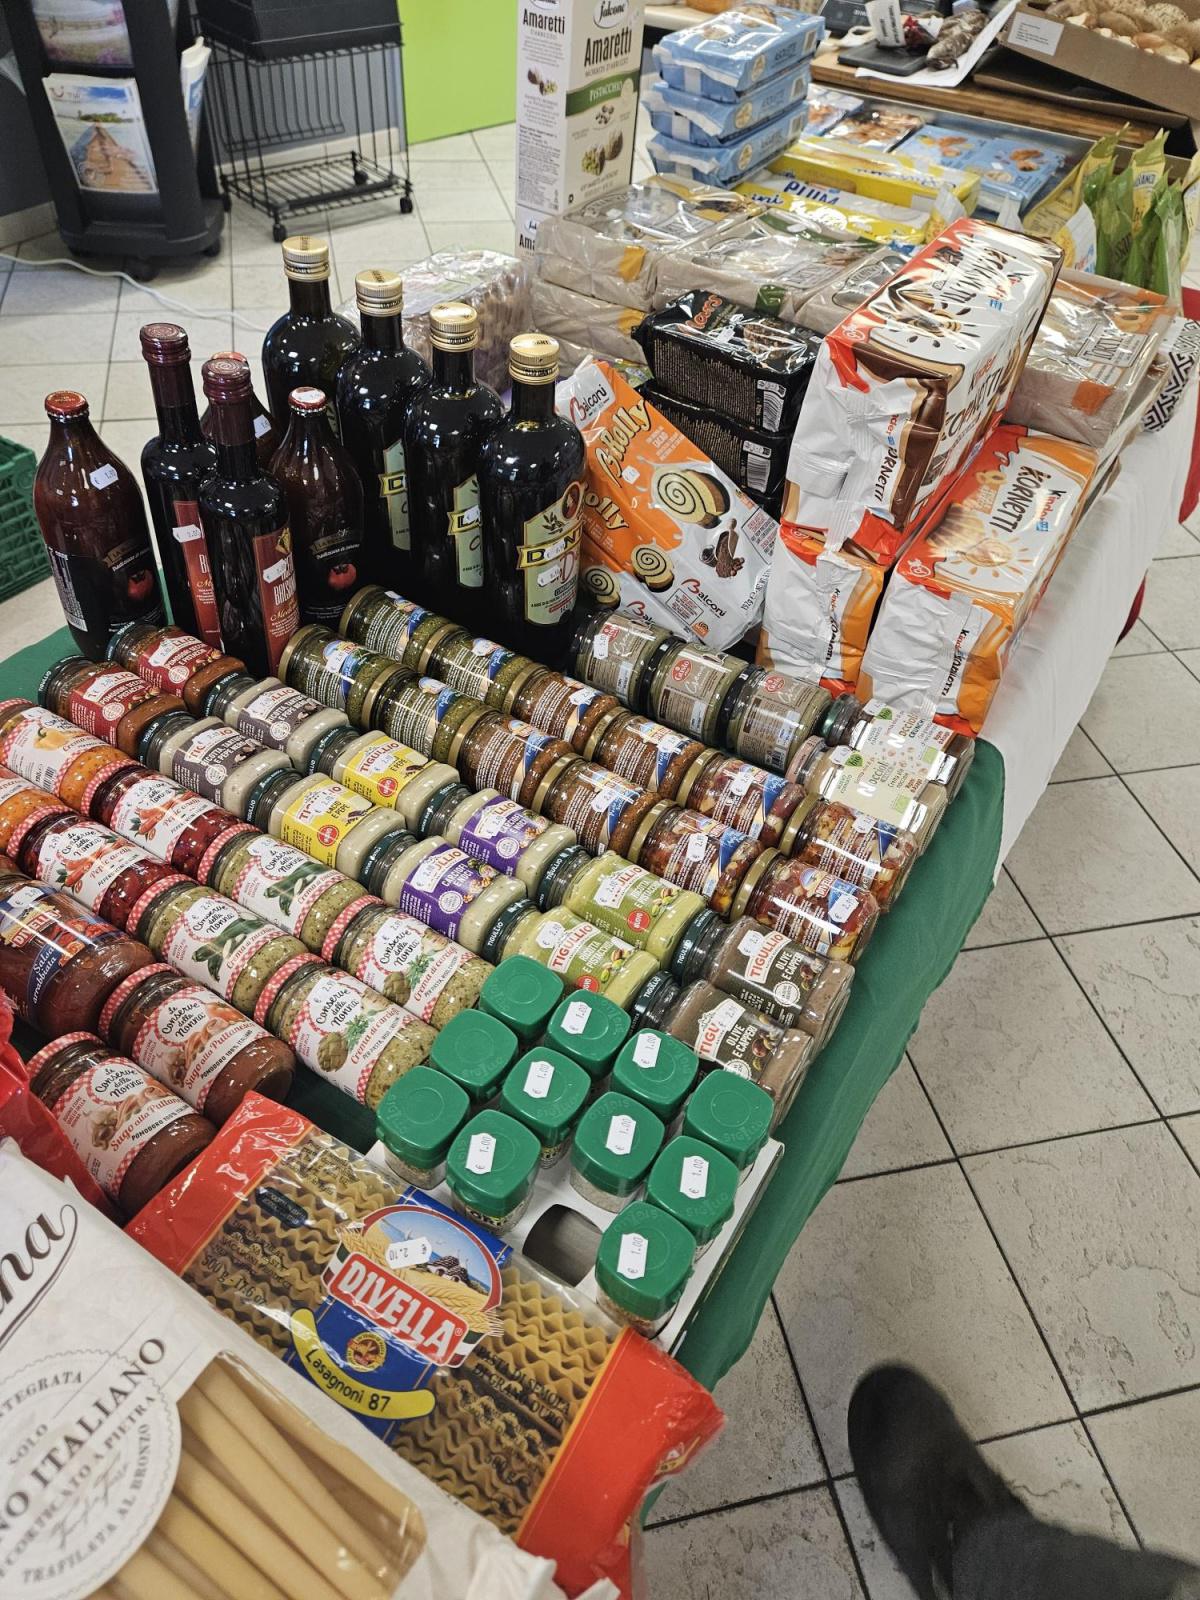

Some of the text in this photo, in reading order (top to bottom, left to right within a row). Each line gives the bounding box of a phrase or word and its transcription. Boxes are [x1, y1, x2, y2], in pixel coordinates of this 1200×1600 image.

[523, 9, 565, 34] Amaretti
[584, 26, 632, 67] Amaretti
[570, 384, 607, 424] Balconi
[681, 578, 727, 618] Balconi
[220, 747, 233, 761] PEPE
[360, 742, 400, 772] TIGULLIO
[394, 759, 406, 769] PEPE
[851, 755, 862, 766] bio
[335, 804, 350, 816] PEPE
[266, 848, 296, 871] Conserve
[277, 856, 303, 873] Nonna
[280, 855, 292, 866] della
[546, 859, 562, 880] TIGULLIO
[442, 863, 466, 886] CARCIOFI
[458, 869, 472, 882] NOCI
[193, 904, 228, 932] Conserve
[206, 912, 235, 935] Nonna
[209, 912, 222, 925] della
[380, 930, 411, 965] Conserve
[395, 940, 408, 953] della
[487, 921, 504, 947] TIGULLIO
[551, 924, 592, 969] TIGULLIO
[33, 944, 56, 973] Salsa
[226, 945, 246, 970] Crema
[394, 938, 419, 967] Nonna
[677, 939, 691, 964] TIGULLIO
[751, 933, 783, 977] TIGULLIO
[775, 951, 793, 970] OLIVE
[785, 951, 802, 976] CAPPERI
[33, 956, 57, 1004] arrabbiata
[414, 945, 459, 1002] Crema di carciofi
[643, 976, 661, 998] TIGULLIO
[162, 1002, 200, 1035] Conserve
[178, 1012, 193, 1027] della
[317, 988, 350, 1024] Conserve
[331, 1001, 346, 1015] della
[331, 999, 360, 1028] Nonna
[569, 1002, 589, 1032] € 1.00
[175, 1012, 206, 1038] Nonna
[351, 1006, 400, 1064] Crema di carciofi
[726, 1024, 745, 1047] OLIVE
[646, 1032, 659, 1050] 1.00
[732, 1025, 756, 1058] E CAPPERI
[185, 1022, 254, 1090] Sugo alla Puttanesca
[200, 1054, 227, 1080] POMODORO
[225, 1043, 240, 1058] 100%
[362, 1050, 371, 1060] PER
[95, 1069, 137, 1094] Conserve
[110, 1078, 143, 1098] Nonna
[114, 1077, 130, 1088] della
[532, 1062, 549, 1095] € 1.00
[111, 1111, 150, 1151] Sugo alla
[131, 1110, 178, 1141] POMODORO 100%
[621, 1117, 634, 1137] 1.00
[479, 1135, 492, 1154] 1.00
[688, 1158, 705, 1195] € 1.00
[388, 1246, 410, 1262] 2.10
[626, 1236, 644, 1275] € 1.00
[234, 1279, 254, 1297] 17.6
[337, 1260, 456, 1360] DIVELLA
[305, 1347, 391, 1411] Lasagnoni 87
[476, 1346, 571, 1414] PASTA DI SEMOLA
[31, 1337, 166, 1489] ITALIANO
[530, 1400, 565, 1428] DURO
[94, 1452, 105, 1465] A
[104, 1395, 156, 1451] PIETRA
[9, 1423, 49, 1465] SOLO
[22, 1424, 151, 1584] TRAFILATA AL BRONZO
